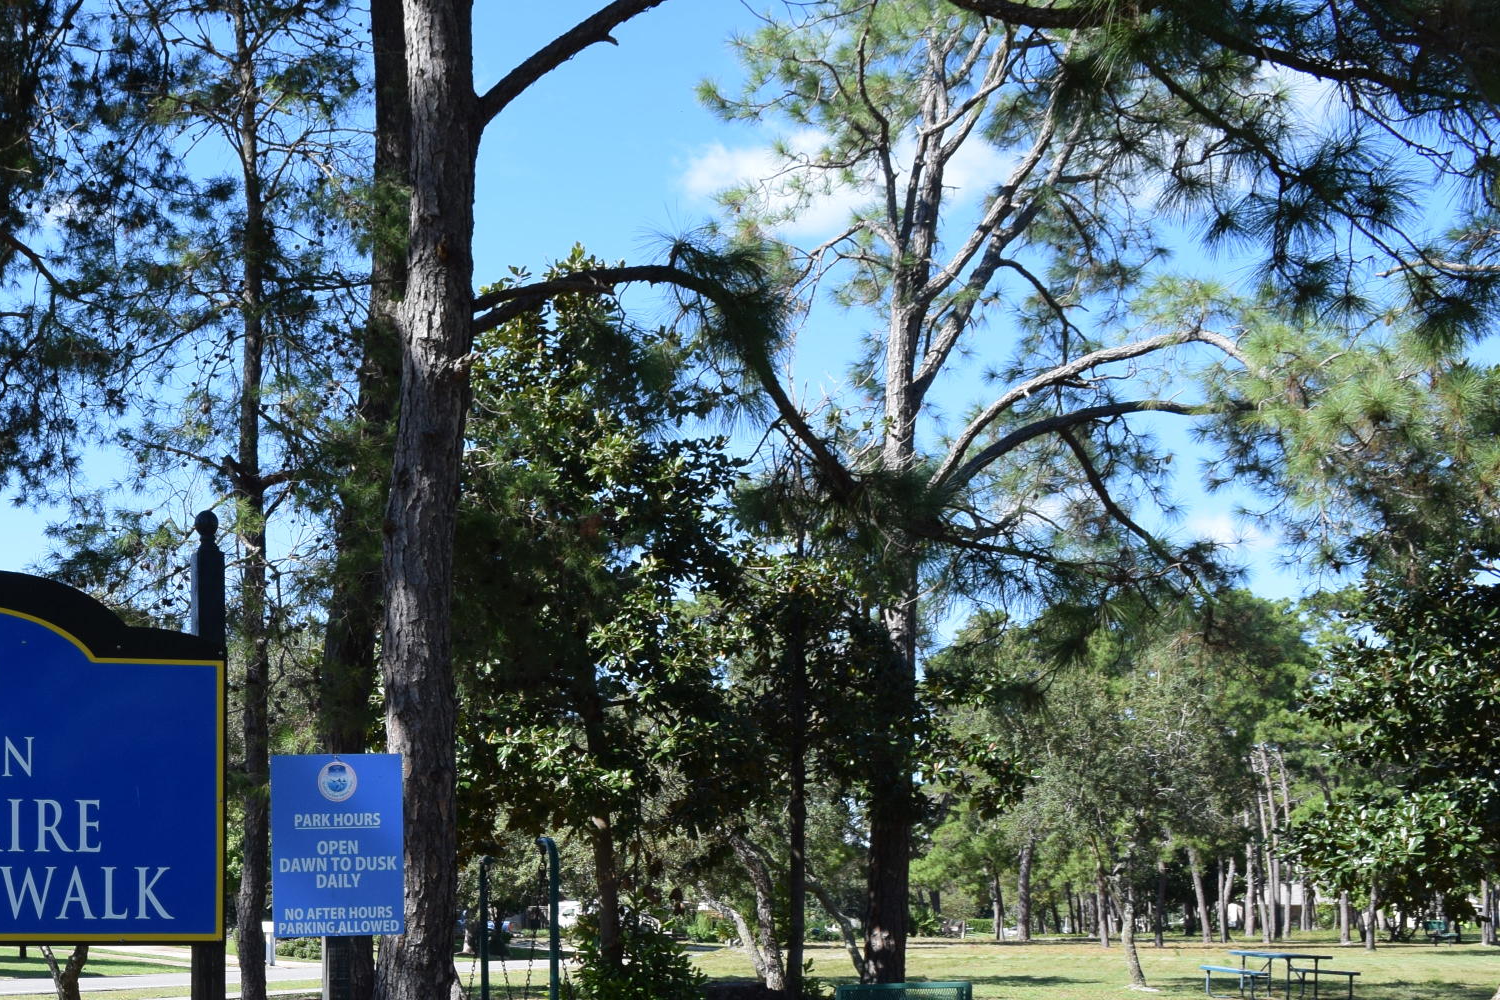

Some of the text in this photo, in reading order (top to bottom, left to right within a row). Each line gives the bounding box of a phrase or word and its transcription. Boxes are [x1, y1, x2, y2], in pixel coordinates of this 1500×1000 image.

[294, 812, 381, 827] PARK HOURS
[317, 840, 359, 855] OPEN
[279, 856, 397, 873] DAWN TO DUSK
[316, 873, 362, 889] DAILY
[0, 866, 175, 921] WALK
[284, 906, 393, 920] NO AFTER HOURS
[278, 920, 400, 935] PARKING ALLOWED
